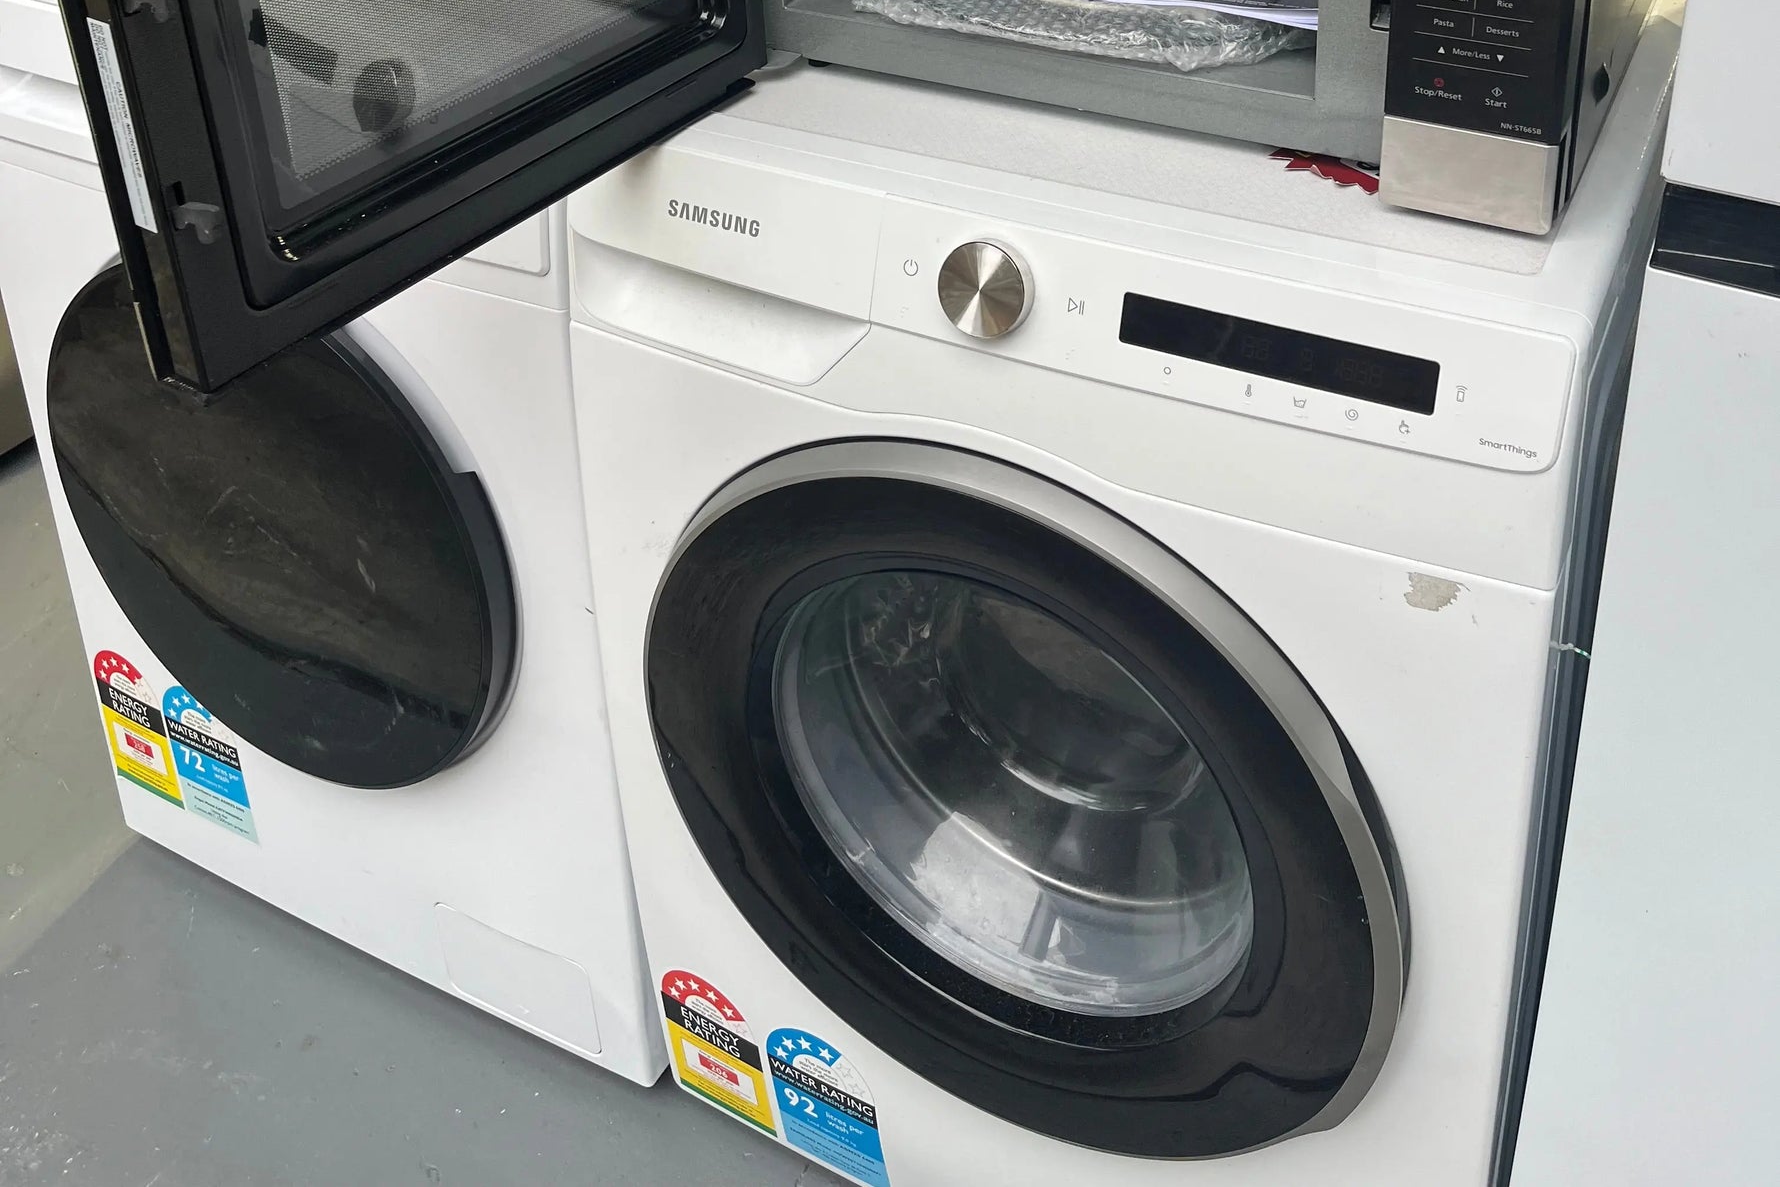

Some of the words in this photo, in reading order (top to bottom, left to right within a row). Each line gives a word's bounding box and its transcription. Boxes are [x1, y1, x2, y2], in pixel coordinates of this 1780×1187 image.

[1497, 0, 1513, 9] Rice
[1433, 18, 1455, 28] Pasta
[1486, 26, 1520, 38] Desserts
[1452, 47, 1491, 60] More/Less
[116, 81, 129, 119] CAUTION
[1414, 86, 1462, 101] Stop/Reset
[1485, 98, 1508, 109] Start
[1500, 122, 1542, 135] NN-ST665B
[667, 199, 760, 238] SAMSUNG
[1478, 437, 1538, 459] SmartThings
[108, 687, 148, 716] ENERGY
[112, 700, 151, 728] RATING
[167, 719, 200, 743] WATER
[200, 732, 236, 759] RATING
[180, 745, 206, 773] 72
[681, 1006, 739, 1046] ENERGY
[684, 1019, 741, 1059] RATING
[709, 1063, 729, 1079] 206
[770, 1057, 818, 1090] WATER
[821, 1083, 873, 1117] RATING
[774, 1069, 874, 1125] www.waterrating.gov.au
[783, 1087, 819, 1119] 92
[825, 1110, 847, 1128] litres
[850, 1123, 864, 1136] per
[827, 1119, 849, 1135] wash
